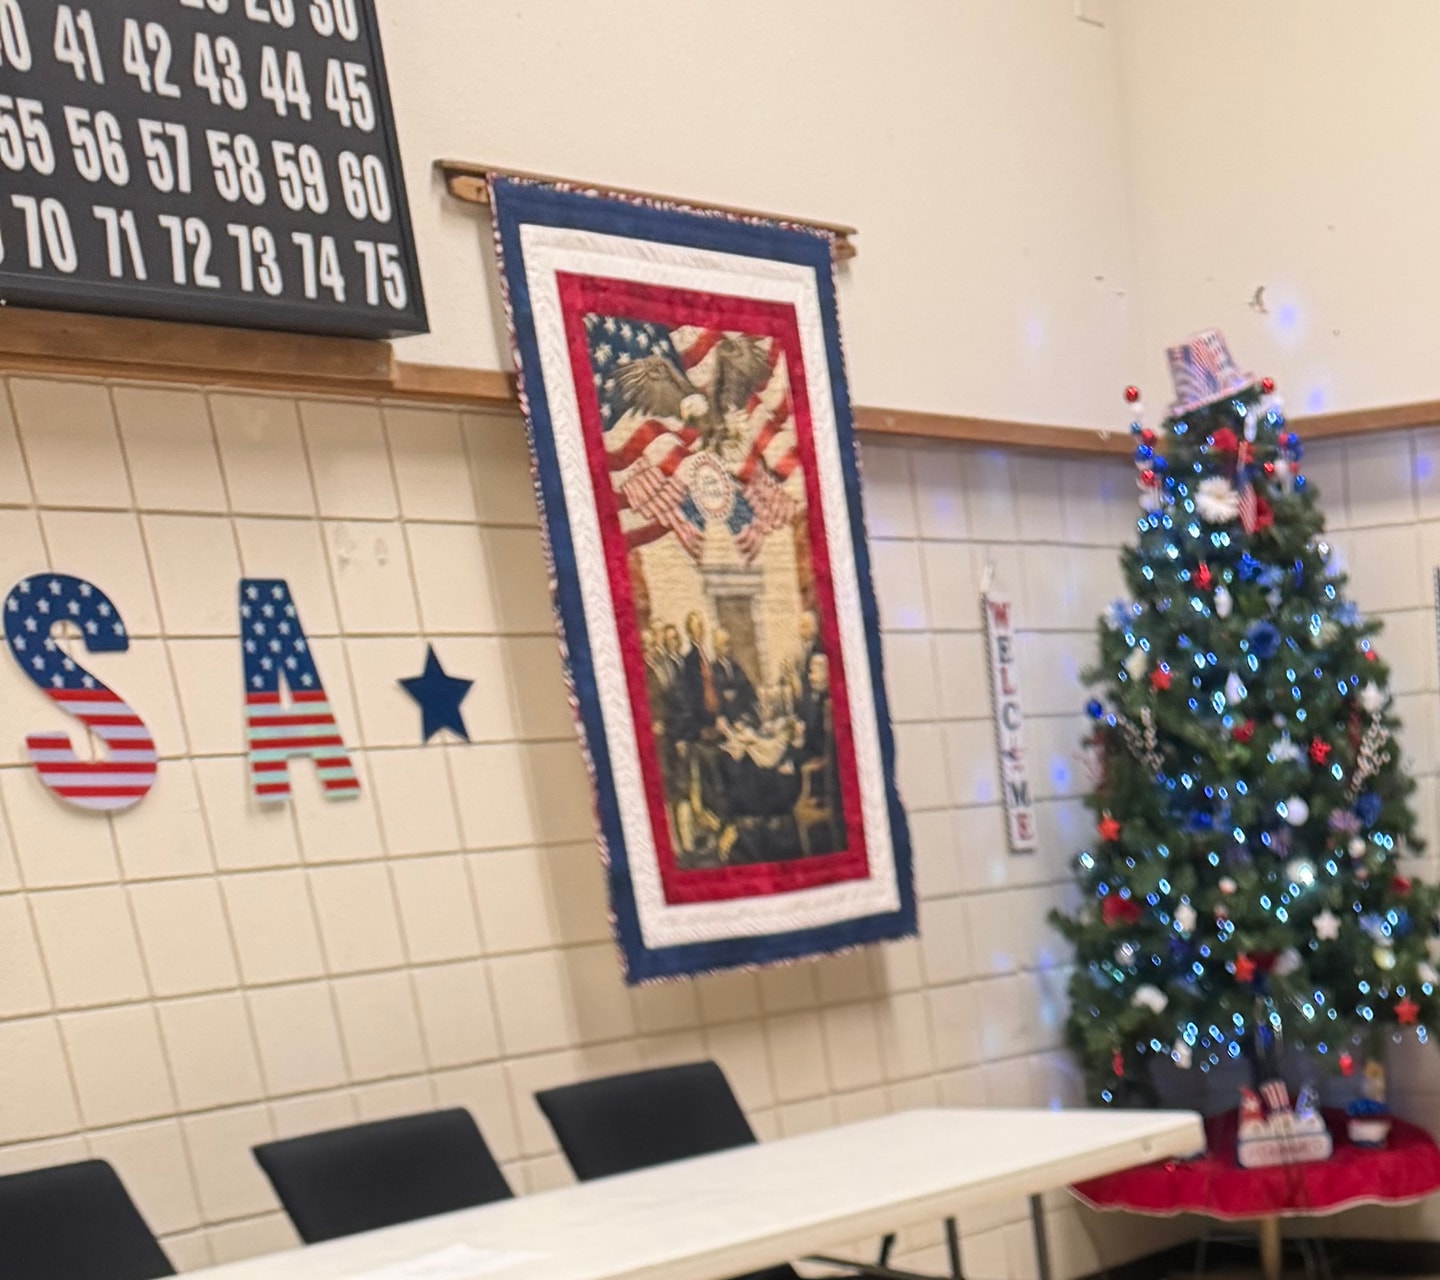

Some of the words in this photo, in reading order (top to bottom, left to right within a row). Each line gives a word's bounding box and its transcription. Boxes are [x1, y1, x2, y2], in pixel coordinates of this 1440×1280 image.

[0, 0, 32, 72] 0
[54, 4, 105, 84] 41
[123, 18, 181, 98] 42
[193, 32, 248, 110] 43
[260, 45, 312, 121] 44
[325, 58, 376, 132] 45
[0, 94, 56, 176] 55
[63, 105, 130, 187] 56
[138, 118, 192, 193] 57
[205, 129, 266, 206] 58
[271, 140, 329, 214] 59
[338, 150, 392, 223] 60
[10, 194, 78, 273] 70
[92, 205, 147, 280] 71
[158, 214, 221, 288] 72
[226, 223, 283, 296] 73
[291, 231, 346, 302] 74
[354, 239, 407, 309] 75
